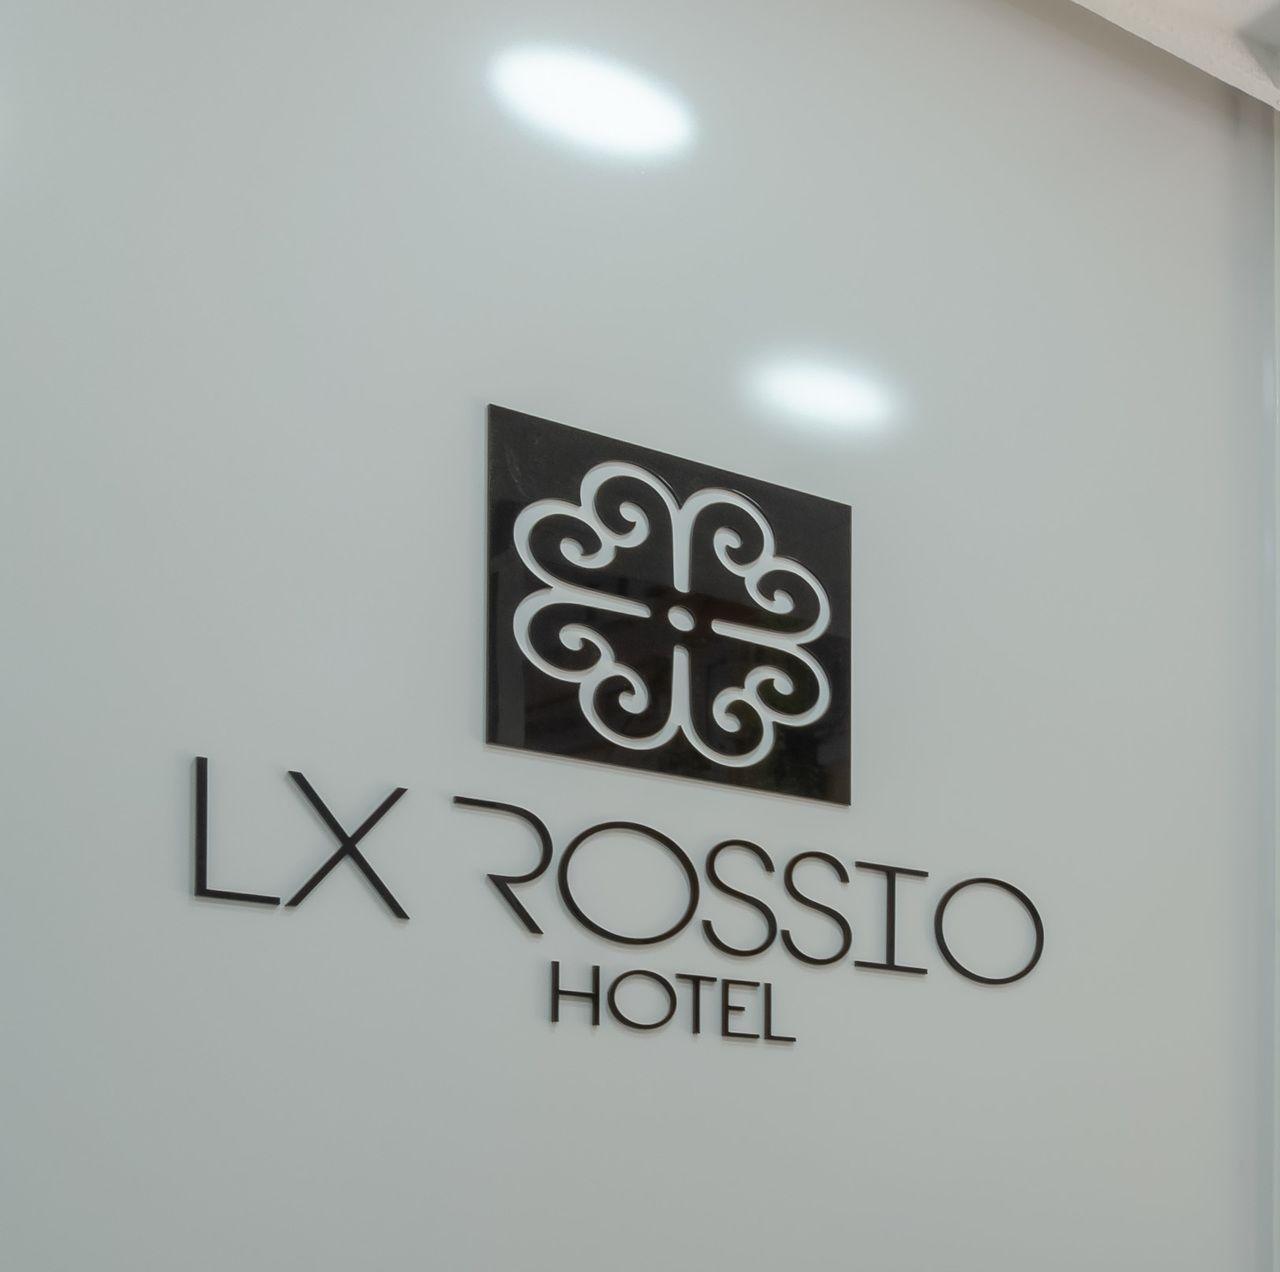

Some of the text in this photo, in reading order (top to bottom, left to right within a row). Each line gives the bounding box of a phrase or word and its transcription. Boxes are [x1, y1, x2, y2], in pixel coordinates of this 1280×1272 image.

[193, 756, 1045, 986] LX ROSSIO
[550, 960, 797, 1043] HOTEL
